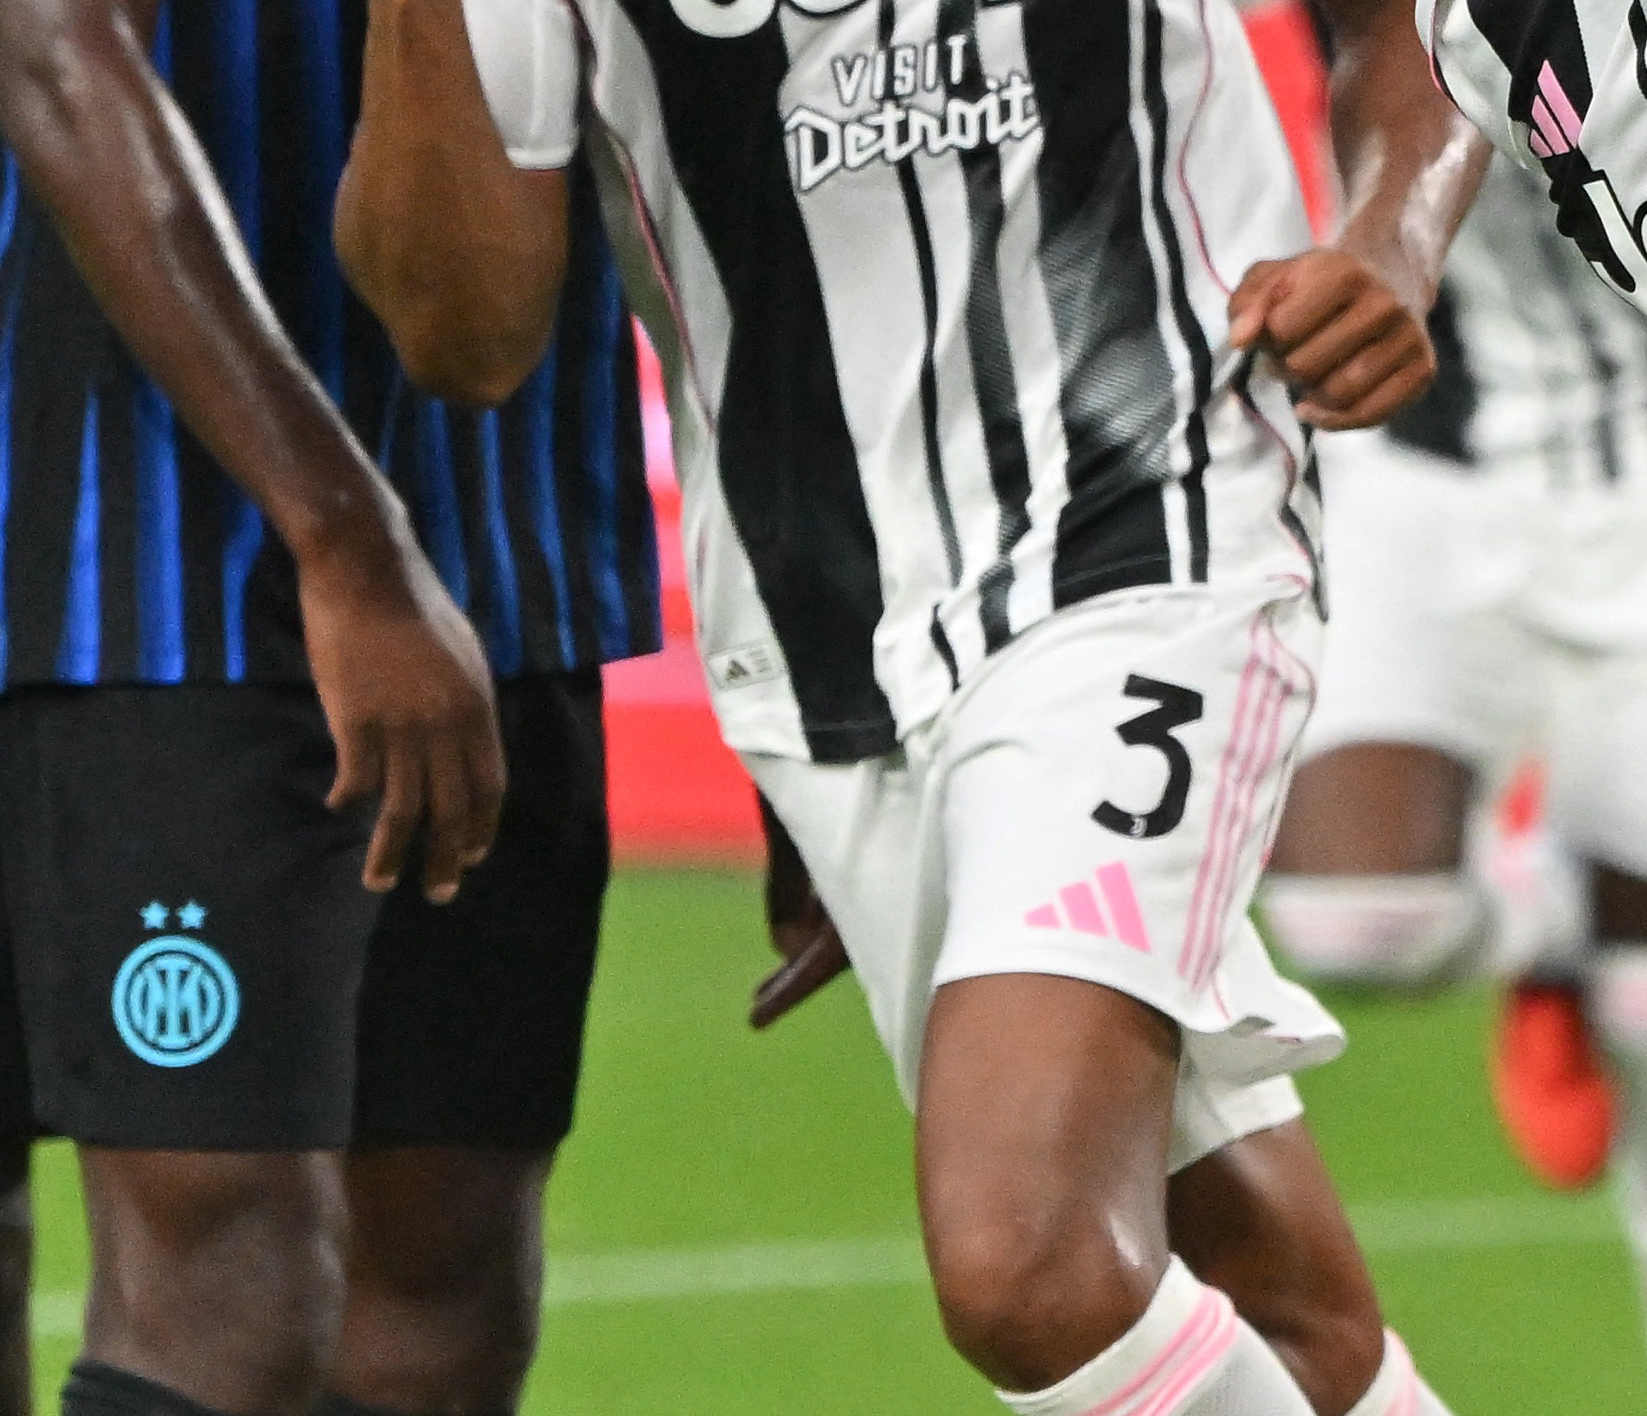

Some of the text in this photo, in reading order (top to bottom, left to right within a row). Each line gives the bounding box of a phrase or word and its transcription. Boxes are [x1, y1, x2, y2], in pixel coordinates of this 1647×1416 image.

[832, 34, 970, 106] VISIT
[784, 71, 1043, 191] Detroit
[1090, 672, 1204, 839] 3
